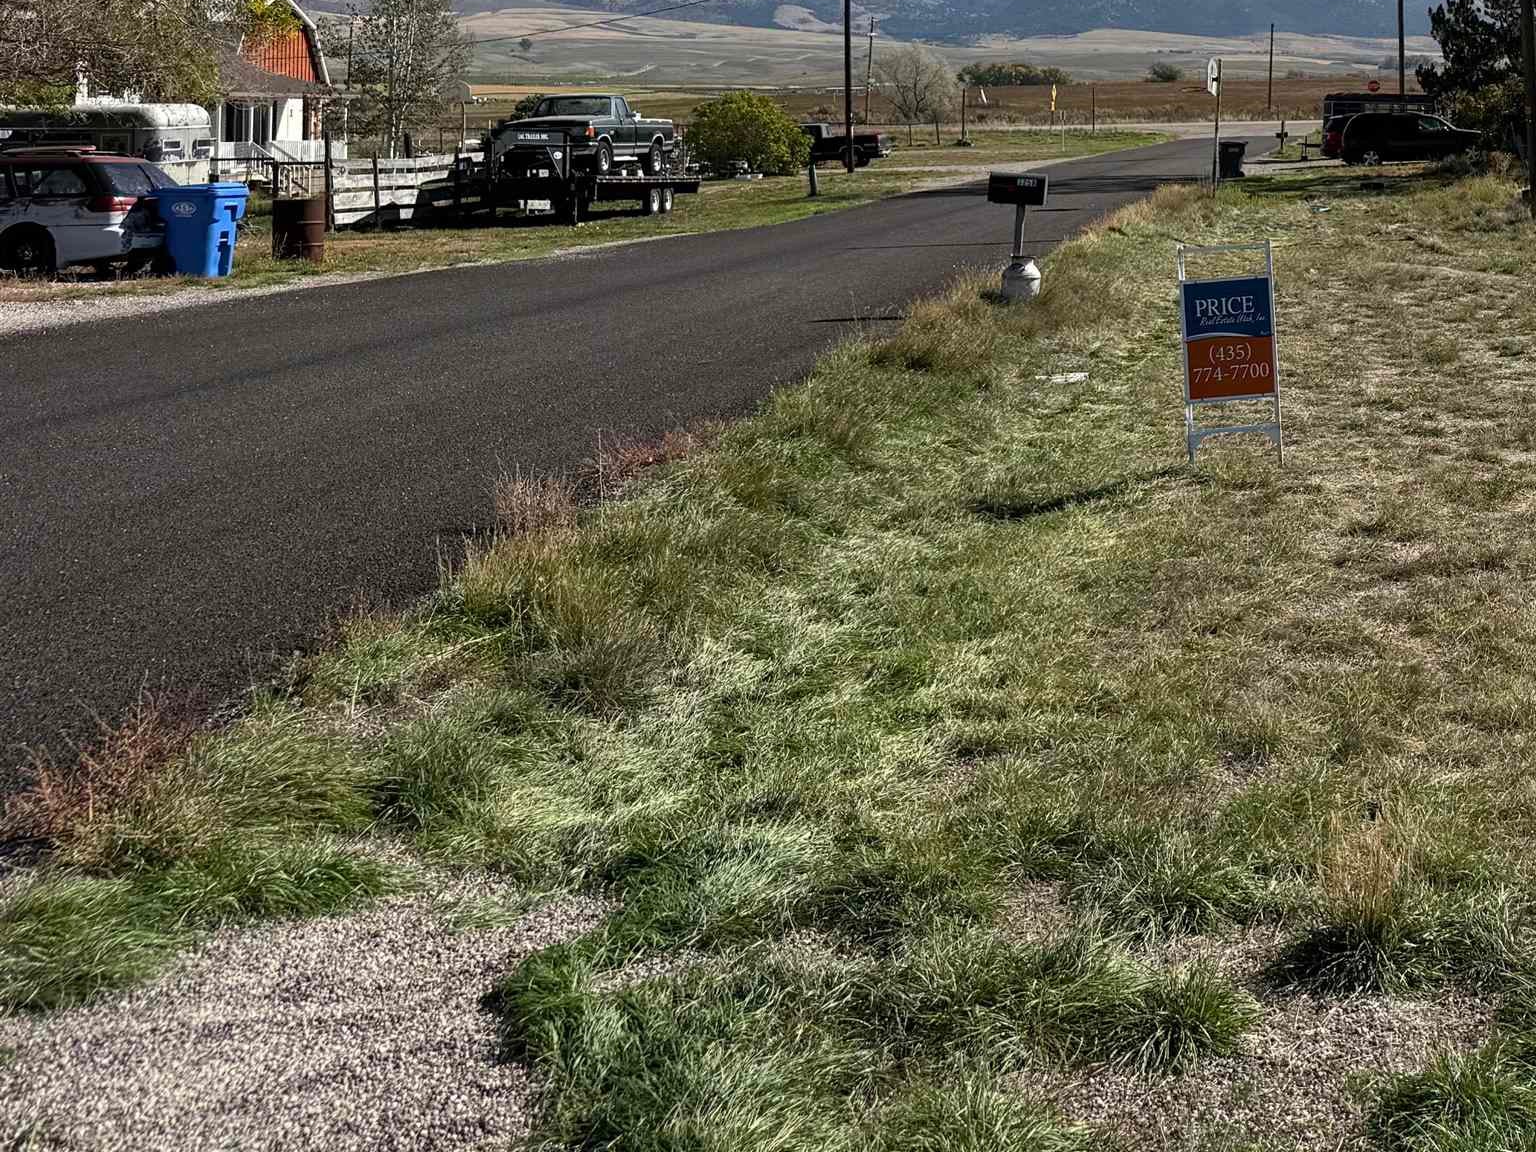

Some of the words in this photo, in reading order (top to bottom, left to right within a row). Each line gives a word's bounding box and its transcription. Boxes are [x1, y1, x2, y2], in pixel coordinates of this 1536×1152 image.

[1195, 295, 1255, 317] PRICE
[1209, 342, 1251, 364] (435)
[1193, 362, 1270, 383] 774-7700
